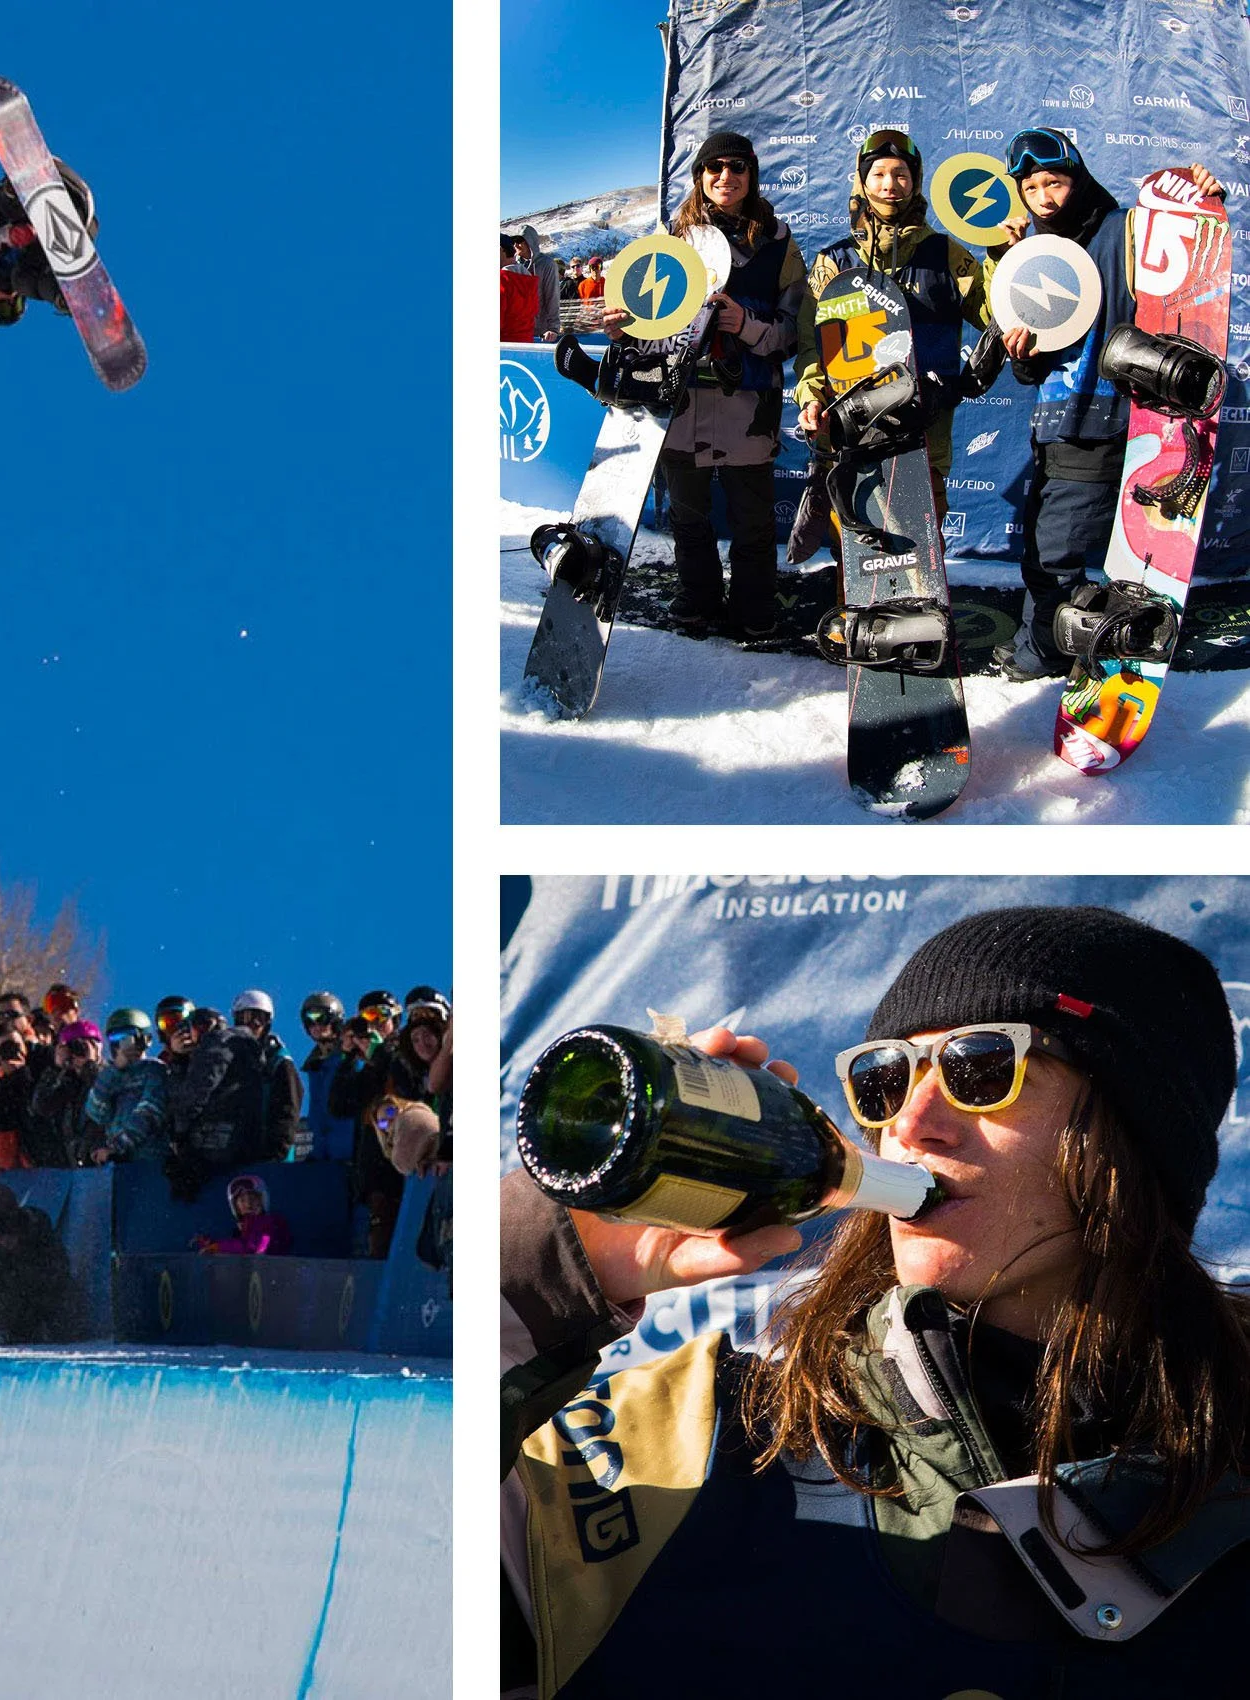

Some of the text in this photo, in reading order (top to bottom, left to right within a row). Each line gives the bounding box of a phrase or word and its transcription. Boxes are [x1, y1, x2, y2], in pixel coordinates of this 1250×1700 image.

[887, 86, 925, 99] VAIL
[1071, 101, 1084, 109] VAIL
[1133, 95, 1191, 108] GARMIN
[770, 135, 817, 145] G-SHOCK
[942, 128, 1004, 140] SHISEIDO
[1106, 133, 1201, 150] BURTONGIRLS.com
[851, 276, 904, 316] G-SHOCK
[816, 297, 870, 321] SMITH
[637, 335, 690, 355] VANS
[944, 477, 995, 491] HISEIDO
[862, 552, 917, 572] GRAVIS
[715, 889, 907, 920] INSULATION
